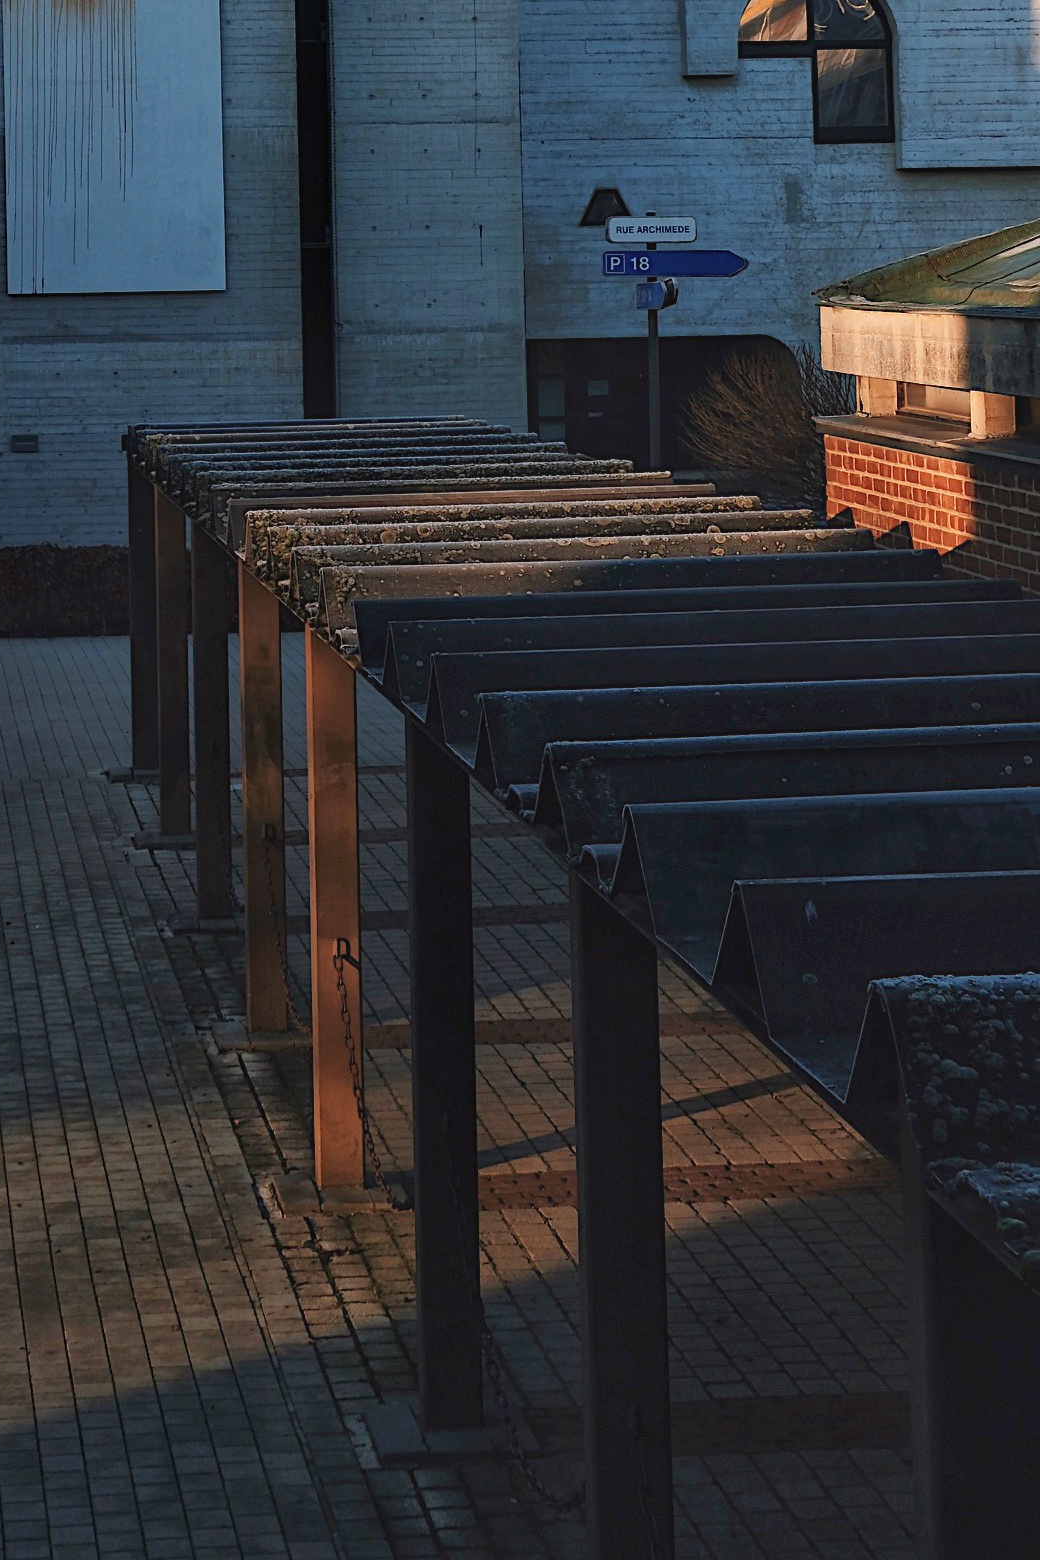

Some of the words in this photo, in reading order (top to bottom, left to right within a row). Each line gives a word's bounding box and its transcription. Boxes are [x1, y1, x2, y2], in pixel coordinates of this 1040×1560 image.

[616, 226, 634, 234] RUE
[636, 225, 690, 234] ARCHIMEDE
[610, 257, 621, 271] P
[630, 257, 650, 271] 18
